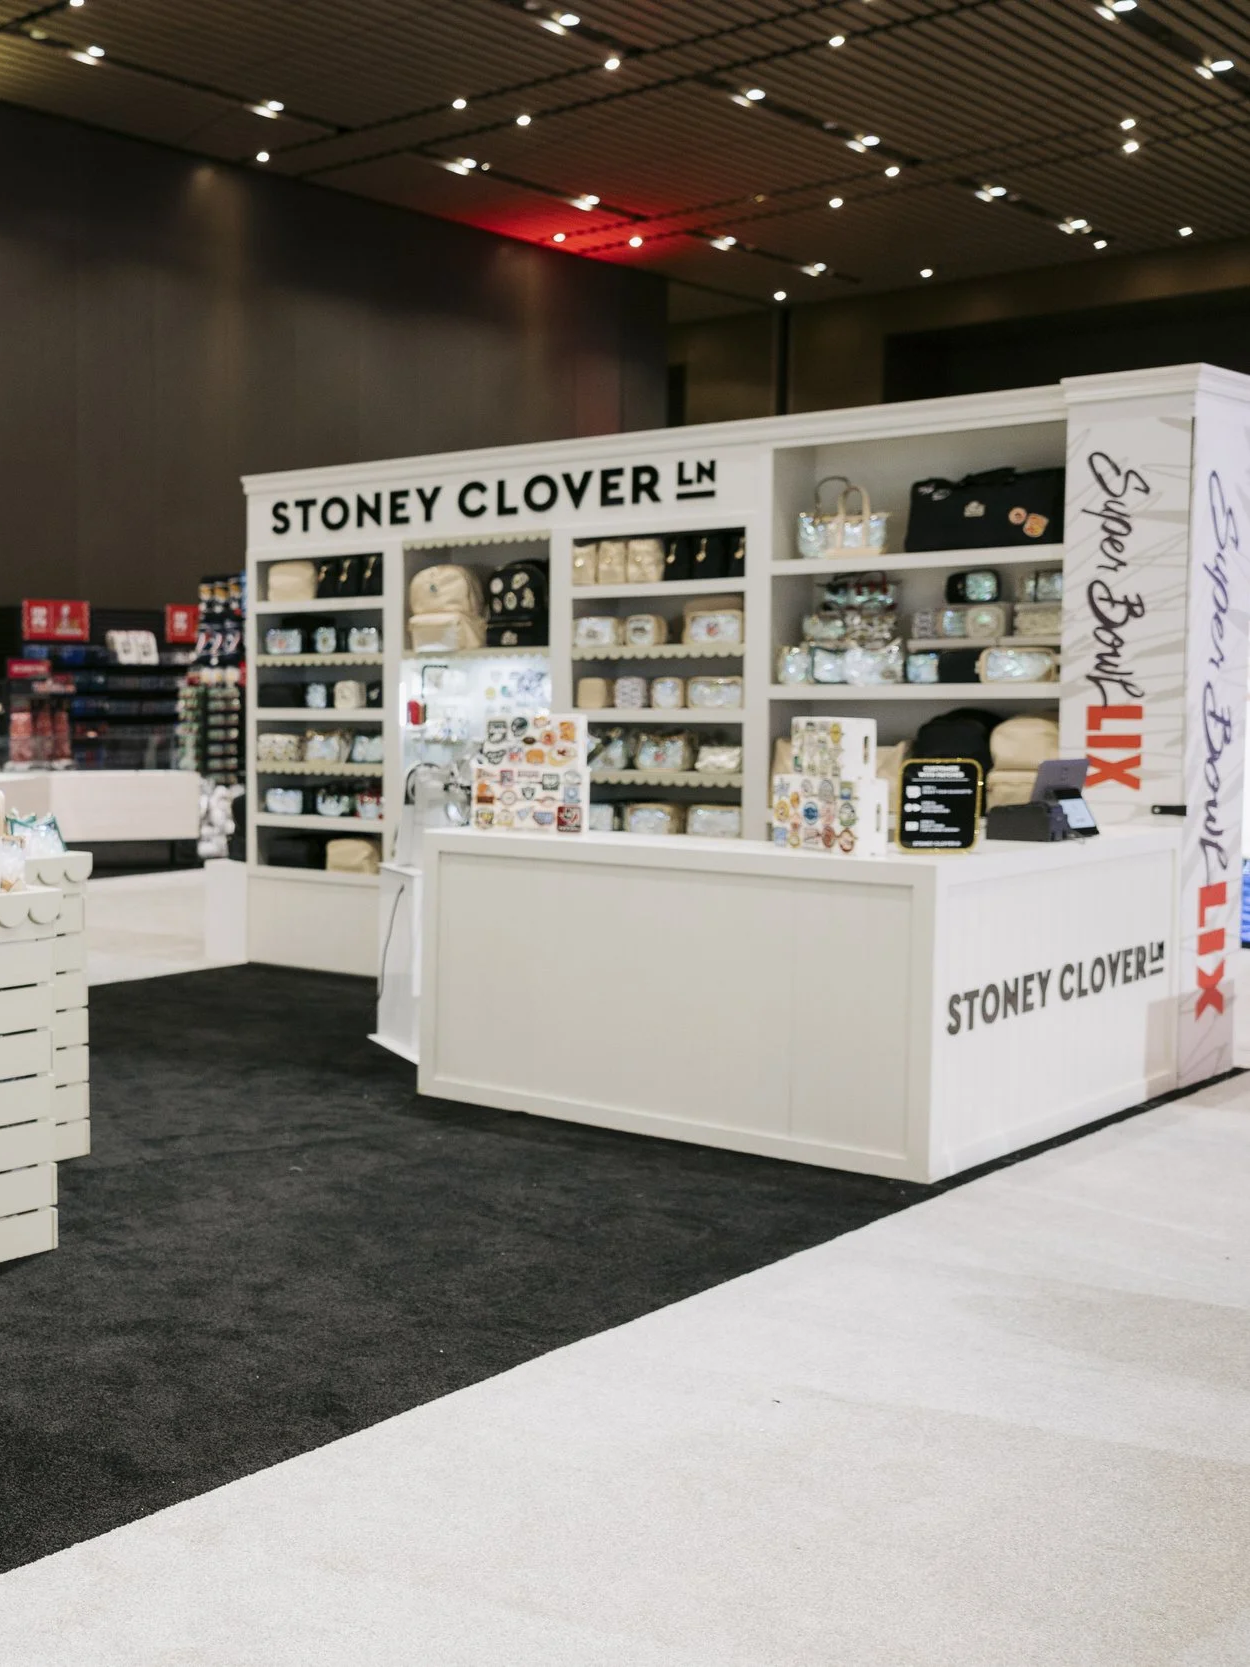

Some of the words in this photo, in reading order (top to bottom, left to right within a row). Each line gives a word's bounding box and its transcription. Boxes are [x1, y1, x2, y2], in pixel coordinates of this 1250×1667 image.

[271, 486, 442, 534] STONEY
[457, 465, 661, 519] CLOVER
[677, 459, 717, 487] LN
[1081, 452, 1150, 572] Super
[1202, 470, 1239, 668] Super
[1085, 580, 1145, 708] Bowl
[1086, 704, 1143, 791] LIX
[1200, 681, 1232, 888] Bowl
[947, 967, 1051, 1036] STONEY
[1059, 945, 1146, 1002] CLOVER
[1195, 881, 1227, 1022] LIX
